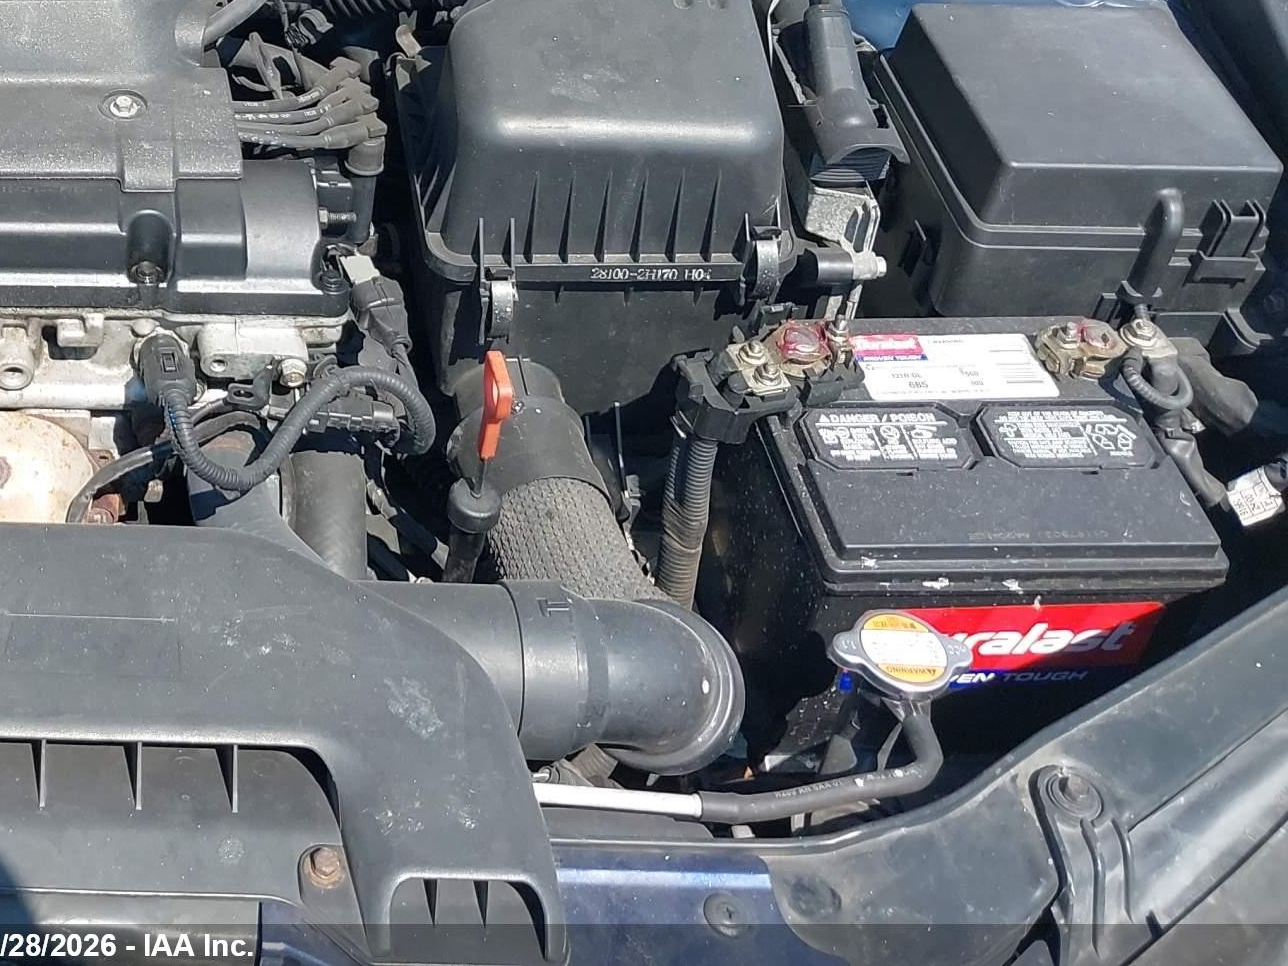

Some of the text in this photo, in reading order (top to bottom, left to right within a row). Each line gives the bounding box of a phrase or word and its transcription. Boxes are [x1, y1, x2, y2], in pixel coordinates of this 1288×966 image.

[830, 414, 880, 423] DANGER
[889, 413, 936, 422] POISON
[1003, 671, 1088, 681] TOUGH
